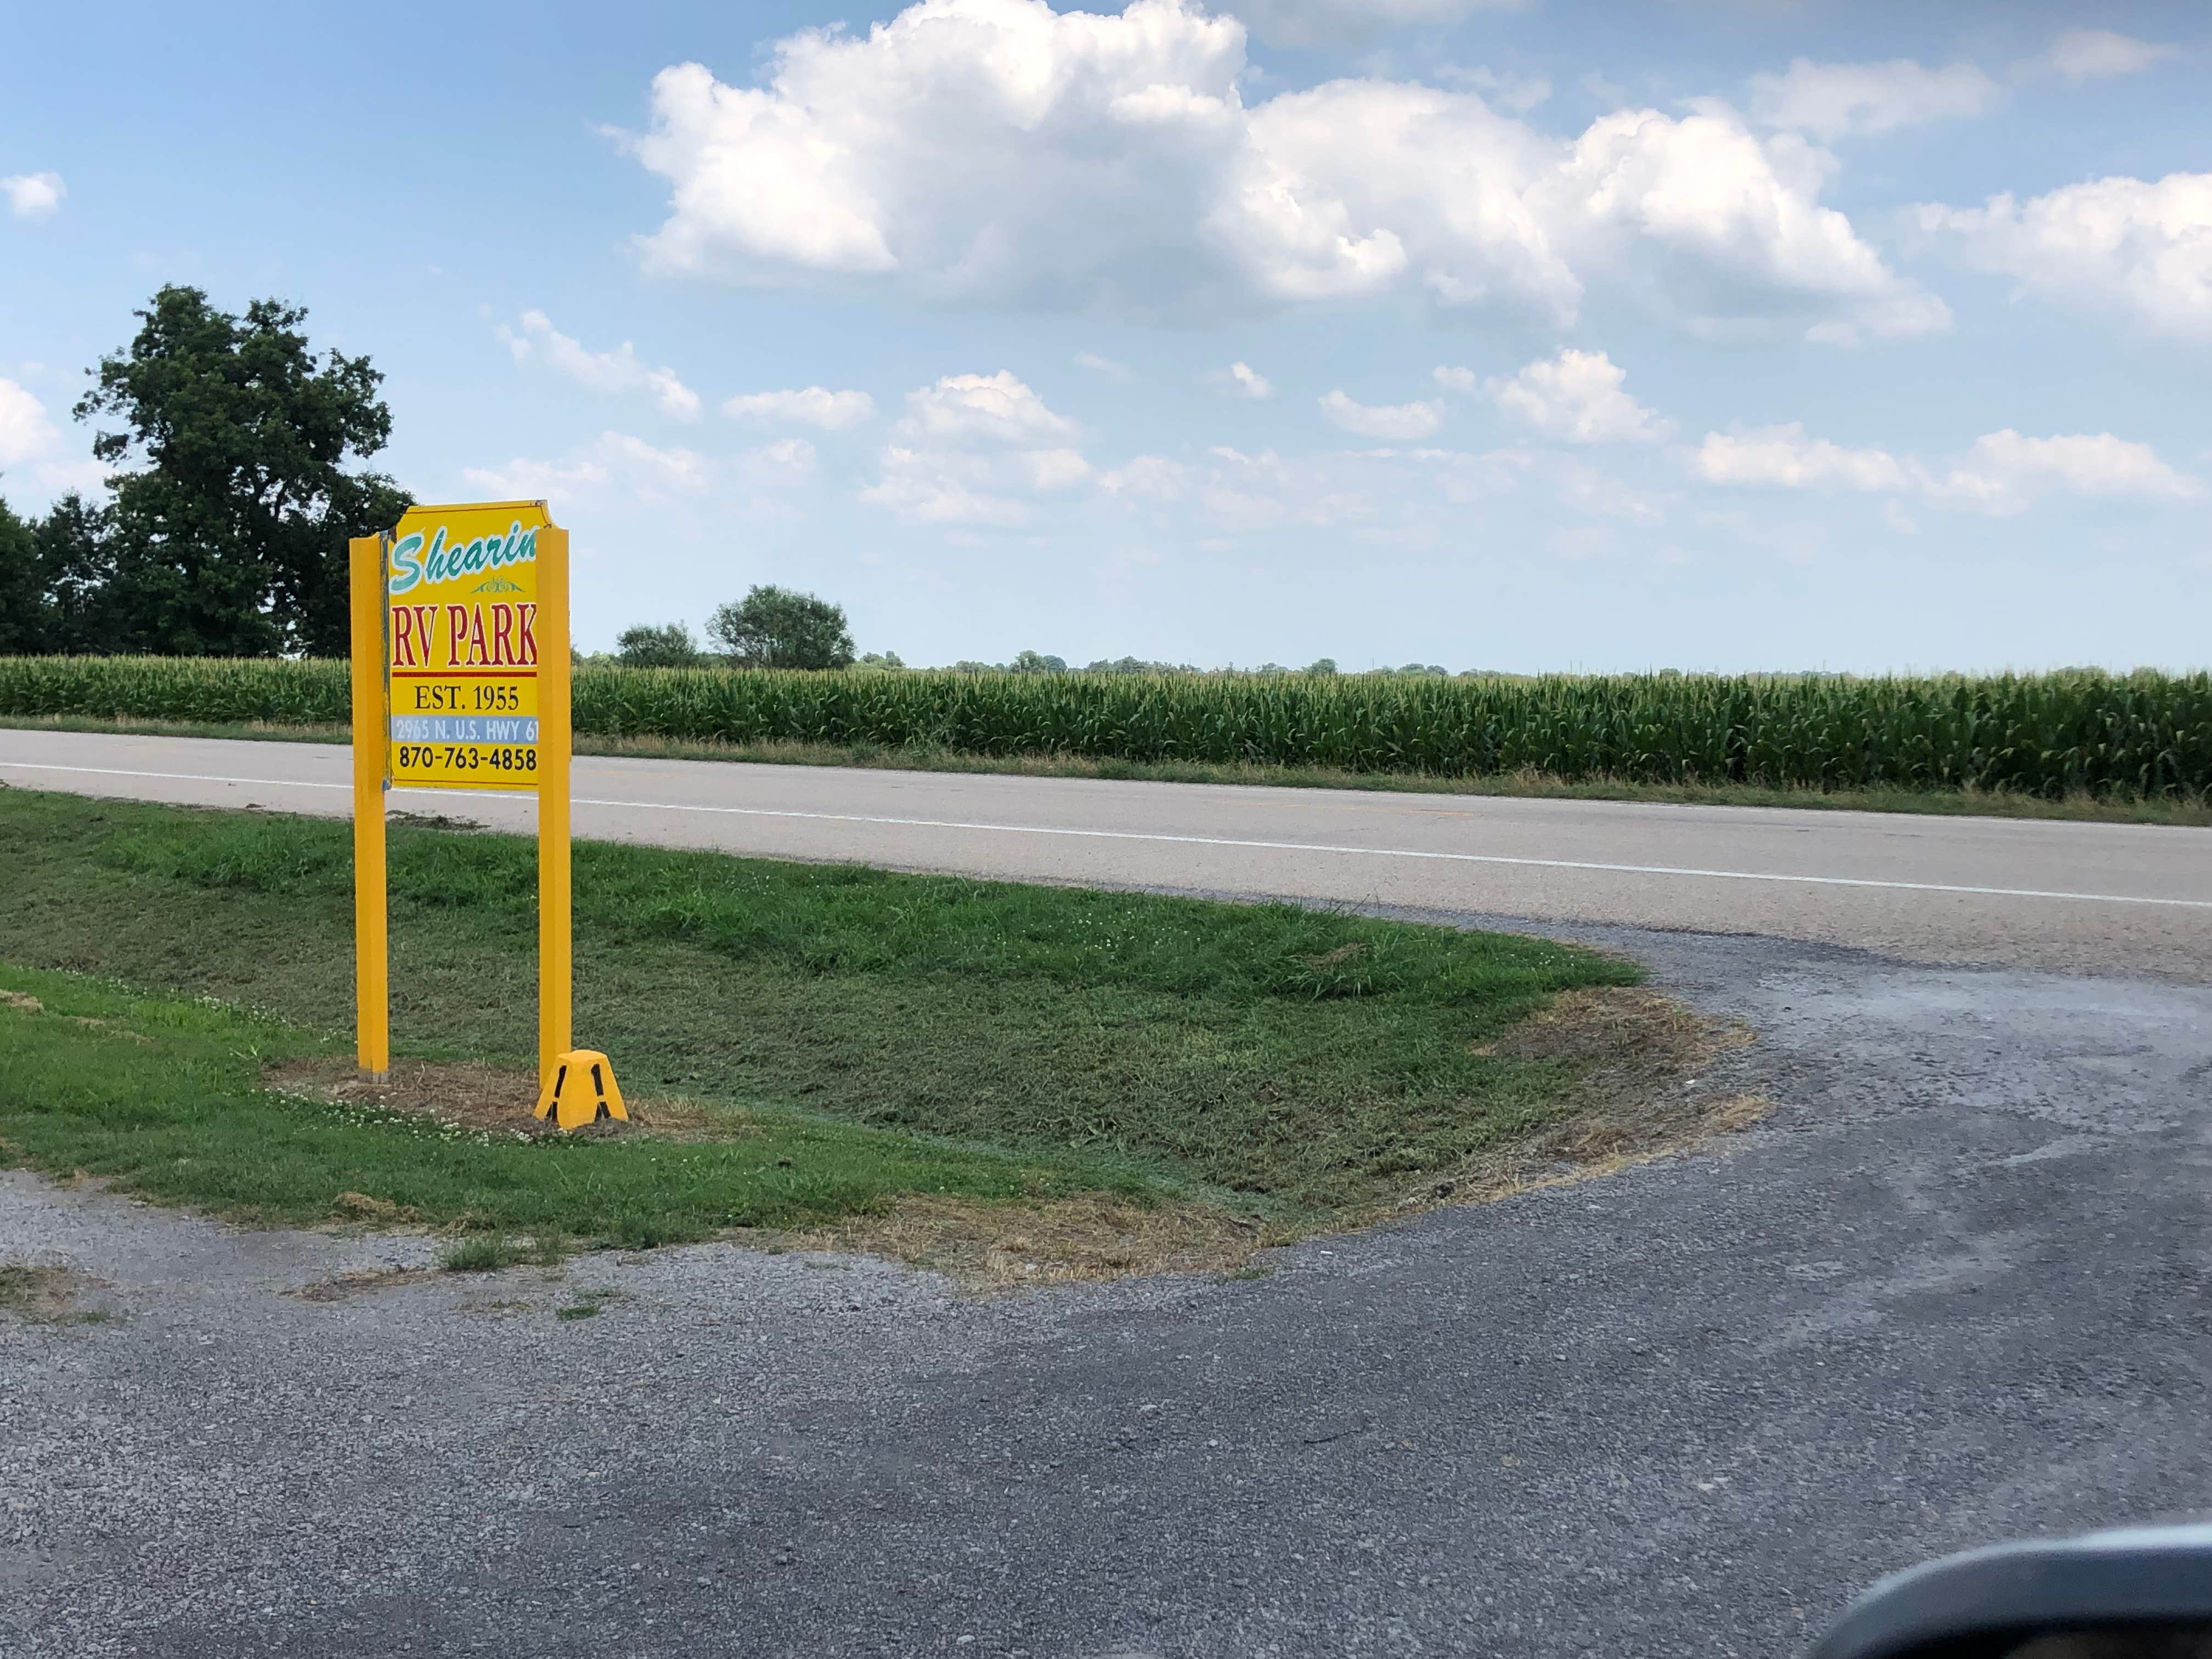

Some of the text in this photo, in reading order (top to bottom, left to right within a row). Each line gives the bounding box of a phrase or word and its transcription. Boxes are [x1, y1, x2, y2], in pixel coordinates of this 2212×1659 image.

[392, 602, 537, 668] RV PARK
[414, 685, 518, 710] EST. 1955
[435, 719, 450, 740] N.
[455, 720, 480, 740] U.S.
[487, 720, 520, 741] HWY
[399, 746, 537, 771] 870-763-4858
